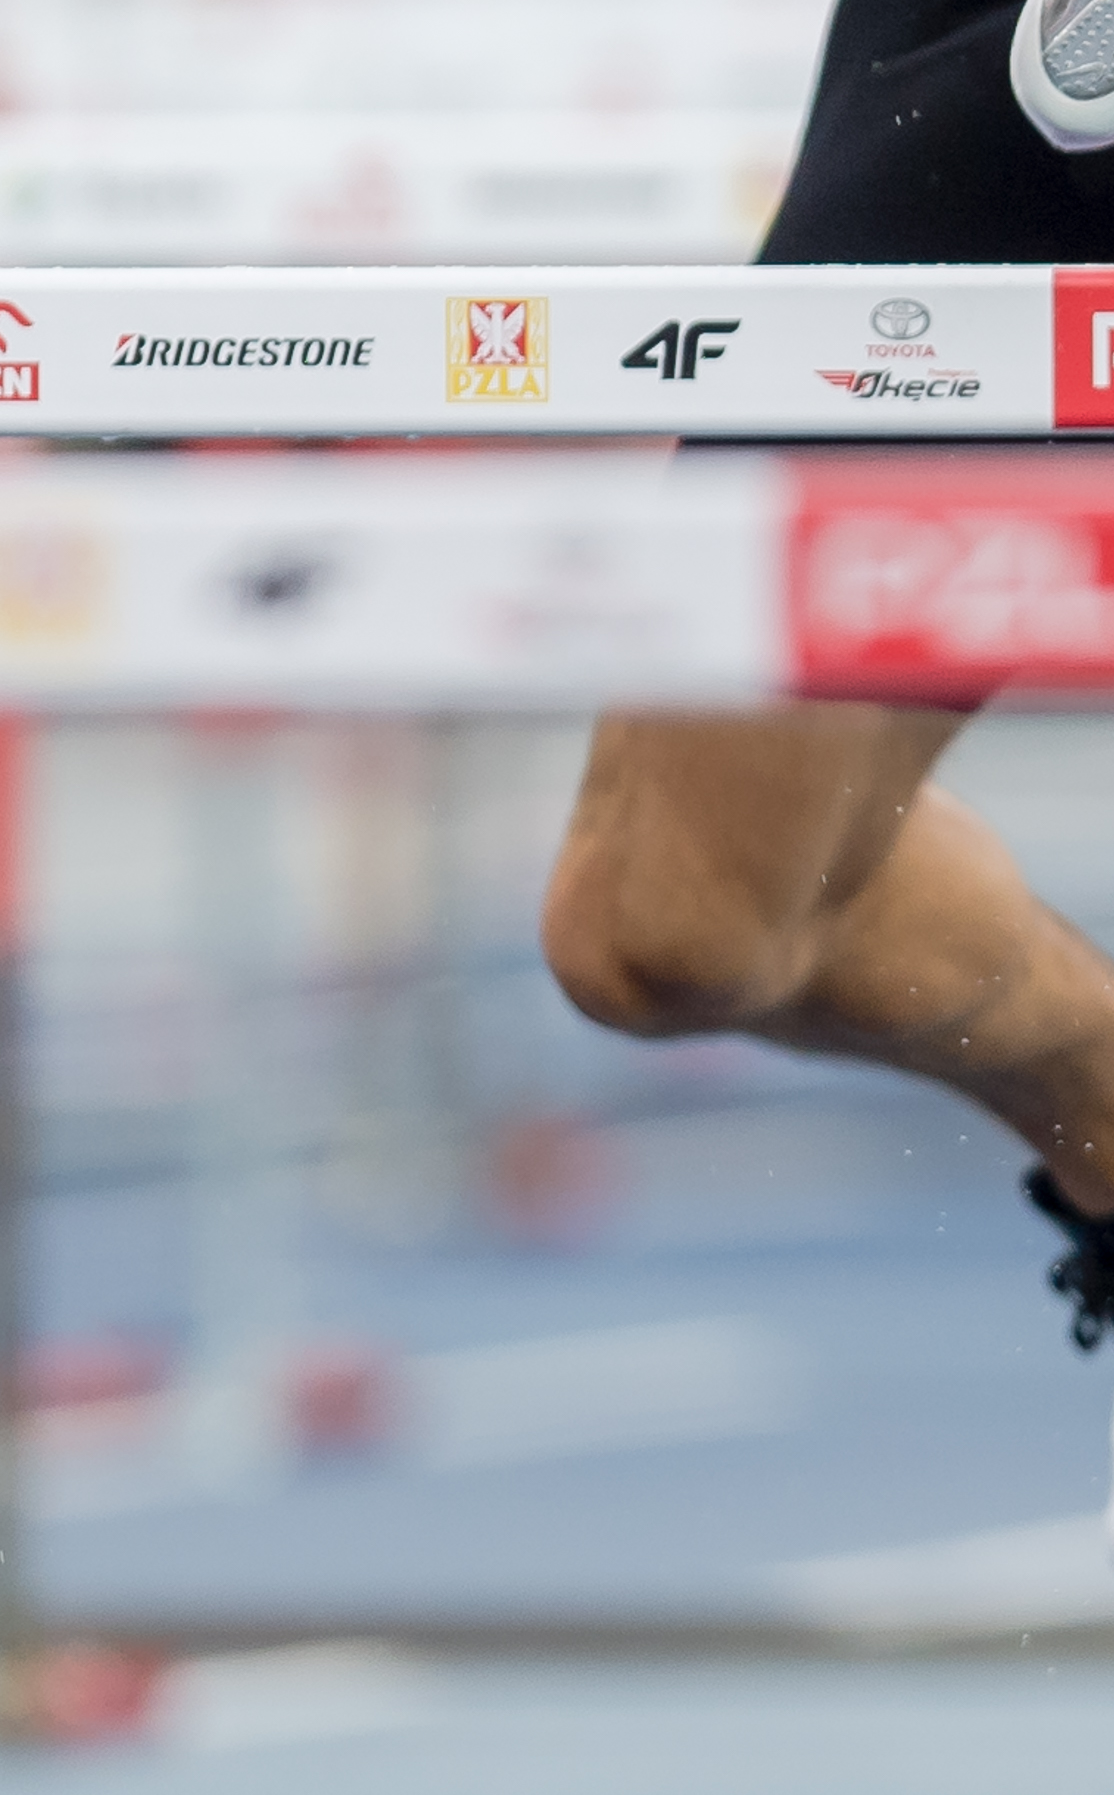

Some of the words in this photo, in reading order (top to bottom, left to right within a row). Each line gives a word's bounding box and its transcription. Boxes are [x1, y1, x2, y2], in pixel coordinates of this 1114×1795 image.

[111, 333, 376, 368] BRIDGESTONE
[620, 317, 743, 381] 4F
[865, 343, 937, 358] TOYOTA
[452, 367, 542, 397] PZLA
